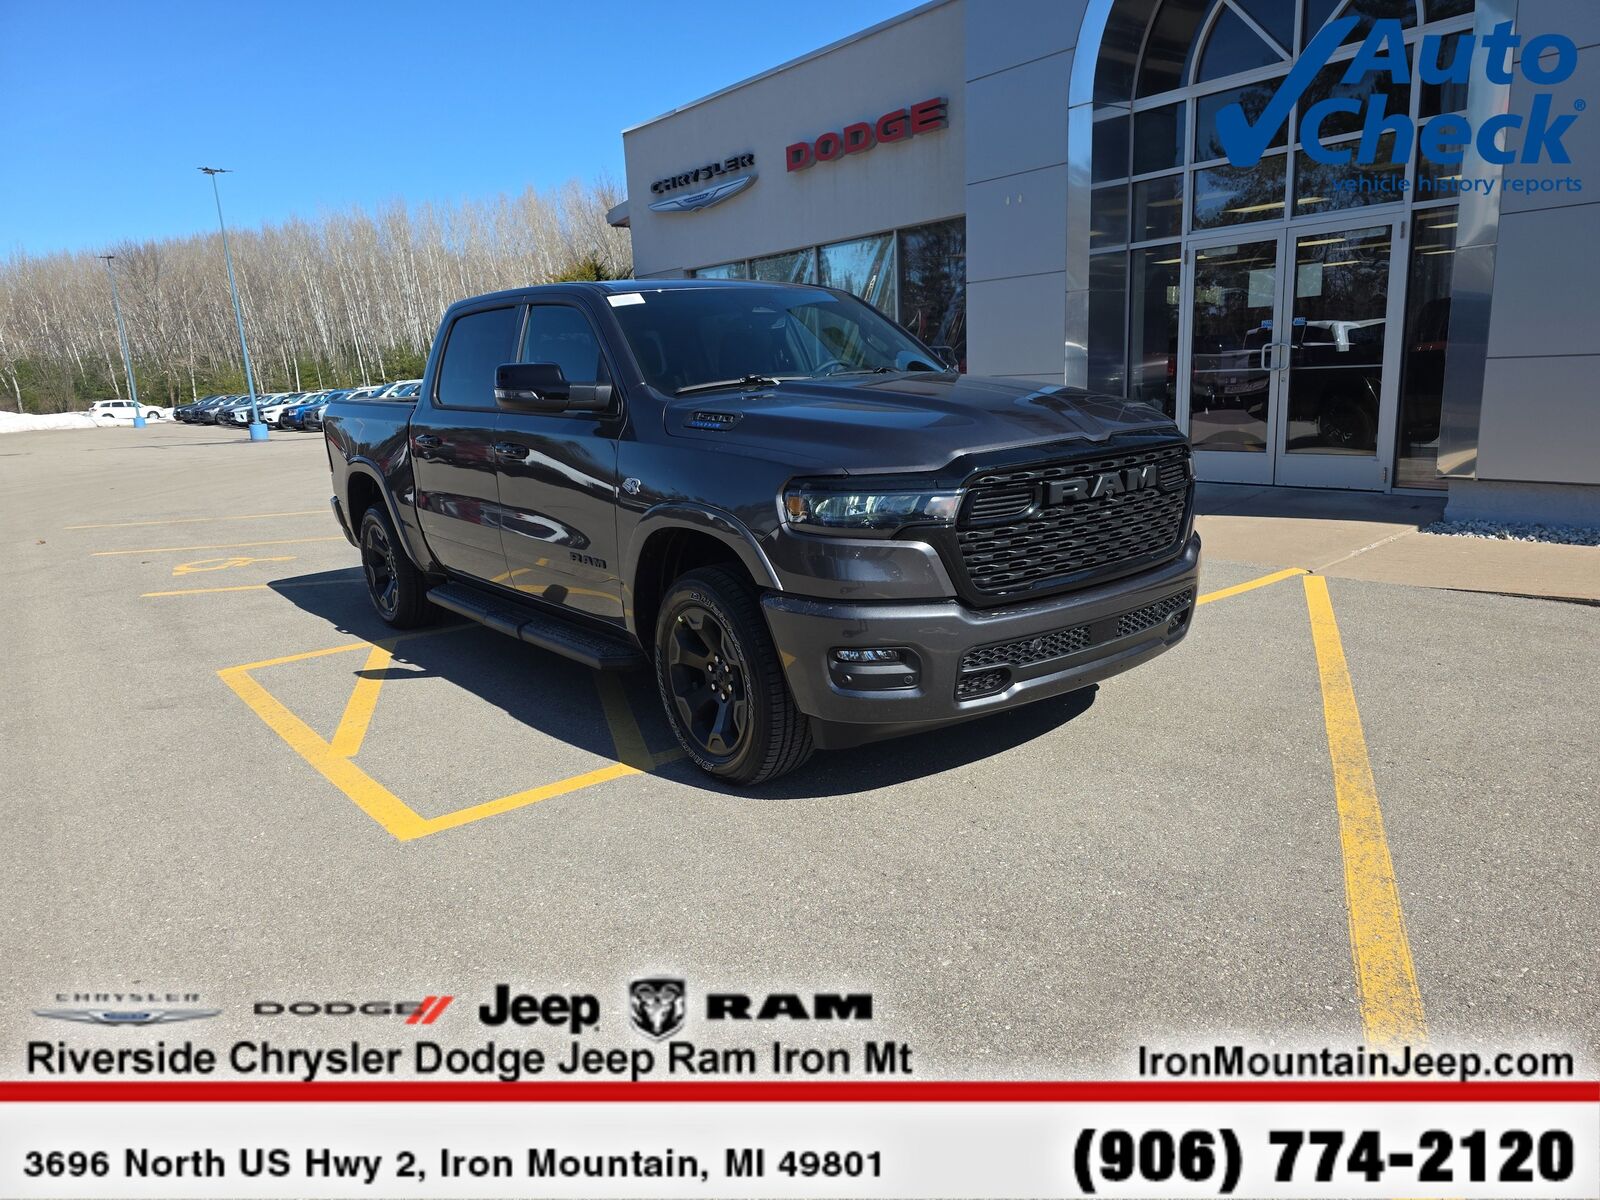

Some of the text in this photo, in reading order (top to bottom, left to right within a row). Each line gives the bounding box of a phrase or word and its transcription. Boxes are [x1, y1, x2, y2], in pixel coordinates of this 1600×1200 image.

[785, 97, 948, 173] DODGE
[650, 152, 755, 194] CHRYSLER
[1048, 464, 1159, 505] RAM
[569, 551, 607, 569] RAM
